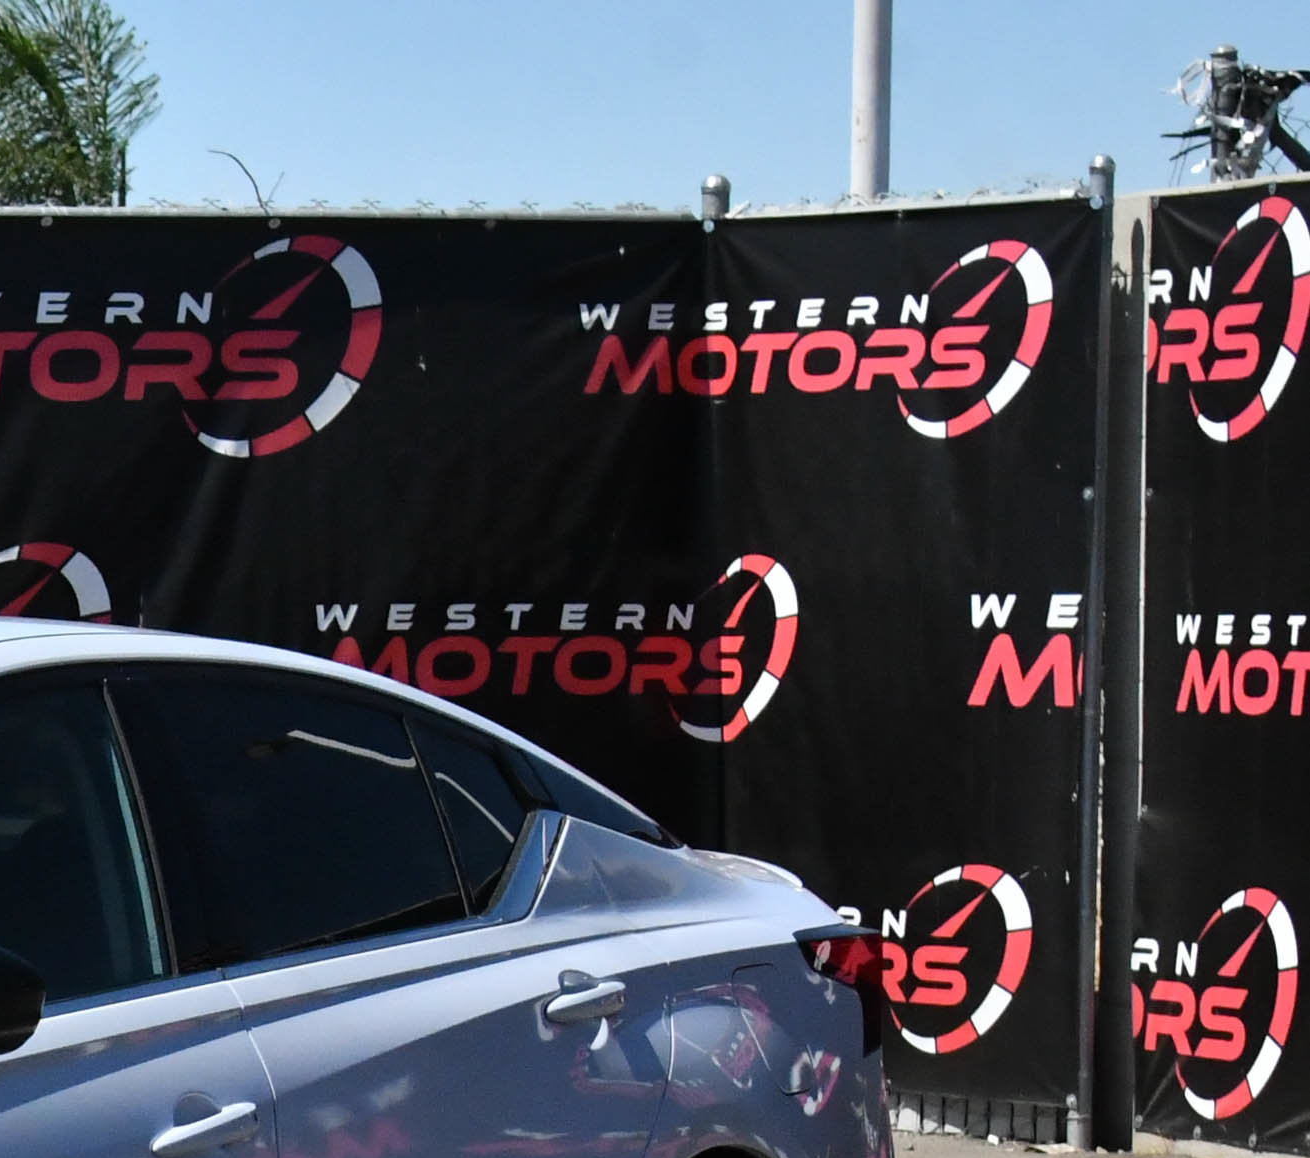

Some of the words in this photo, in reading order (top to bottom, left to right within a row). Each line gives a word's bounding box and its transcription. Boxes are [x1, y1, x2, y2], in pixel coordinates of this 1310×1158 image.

[579, 294, 929, 331] WESTERN
[1147, 302, 1264, 384] RS
[584, 324, 991, 396] MOTORS
[315, 603, 694, 632] WESTERN
[970, 593, 1083, 629] WE
[1176, 613, 1308, 646] WEST
[966, 632, 1084, 709] M
[1175, 648, 1310, 717] MOT
[1132, 979, 1249, 1063] RS
